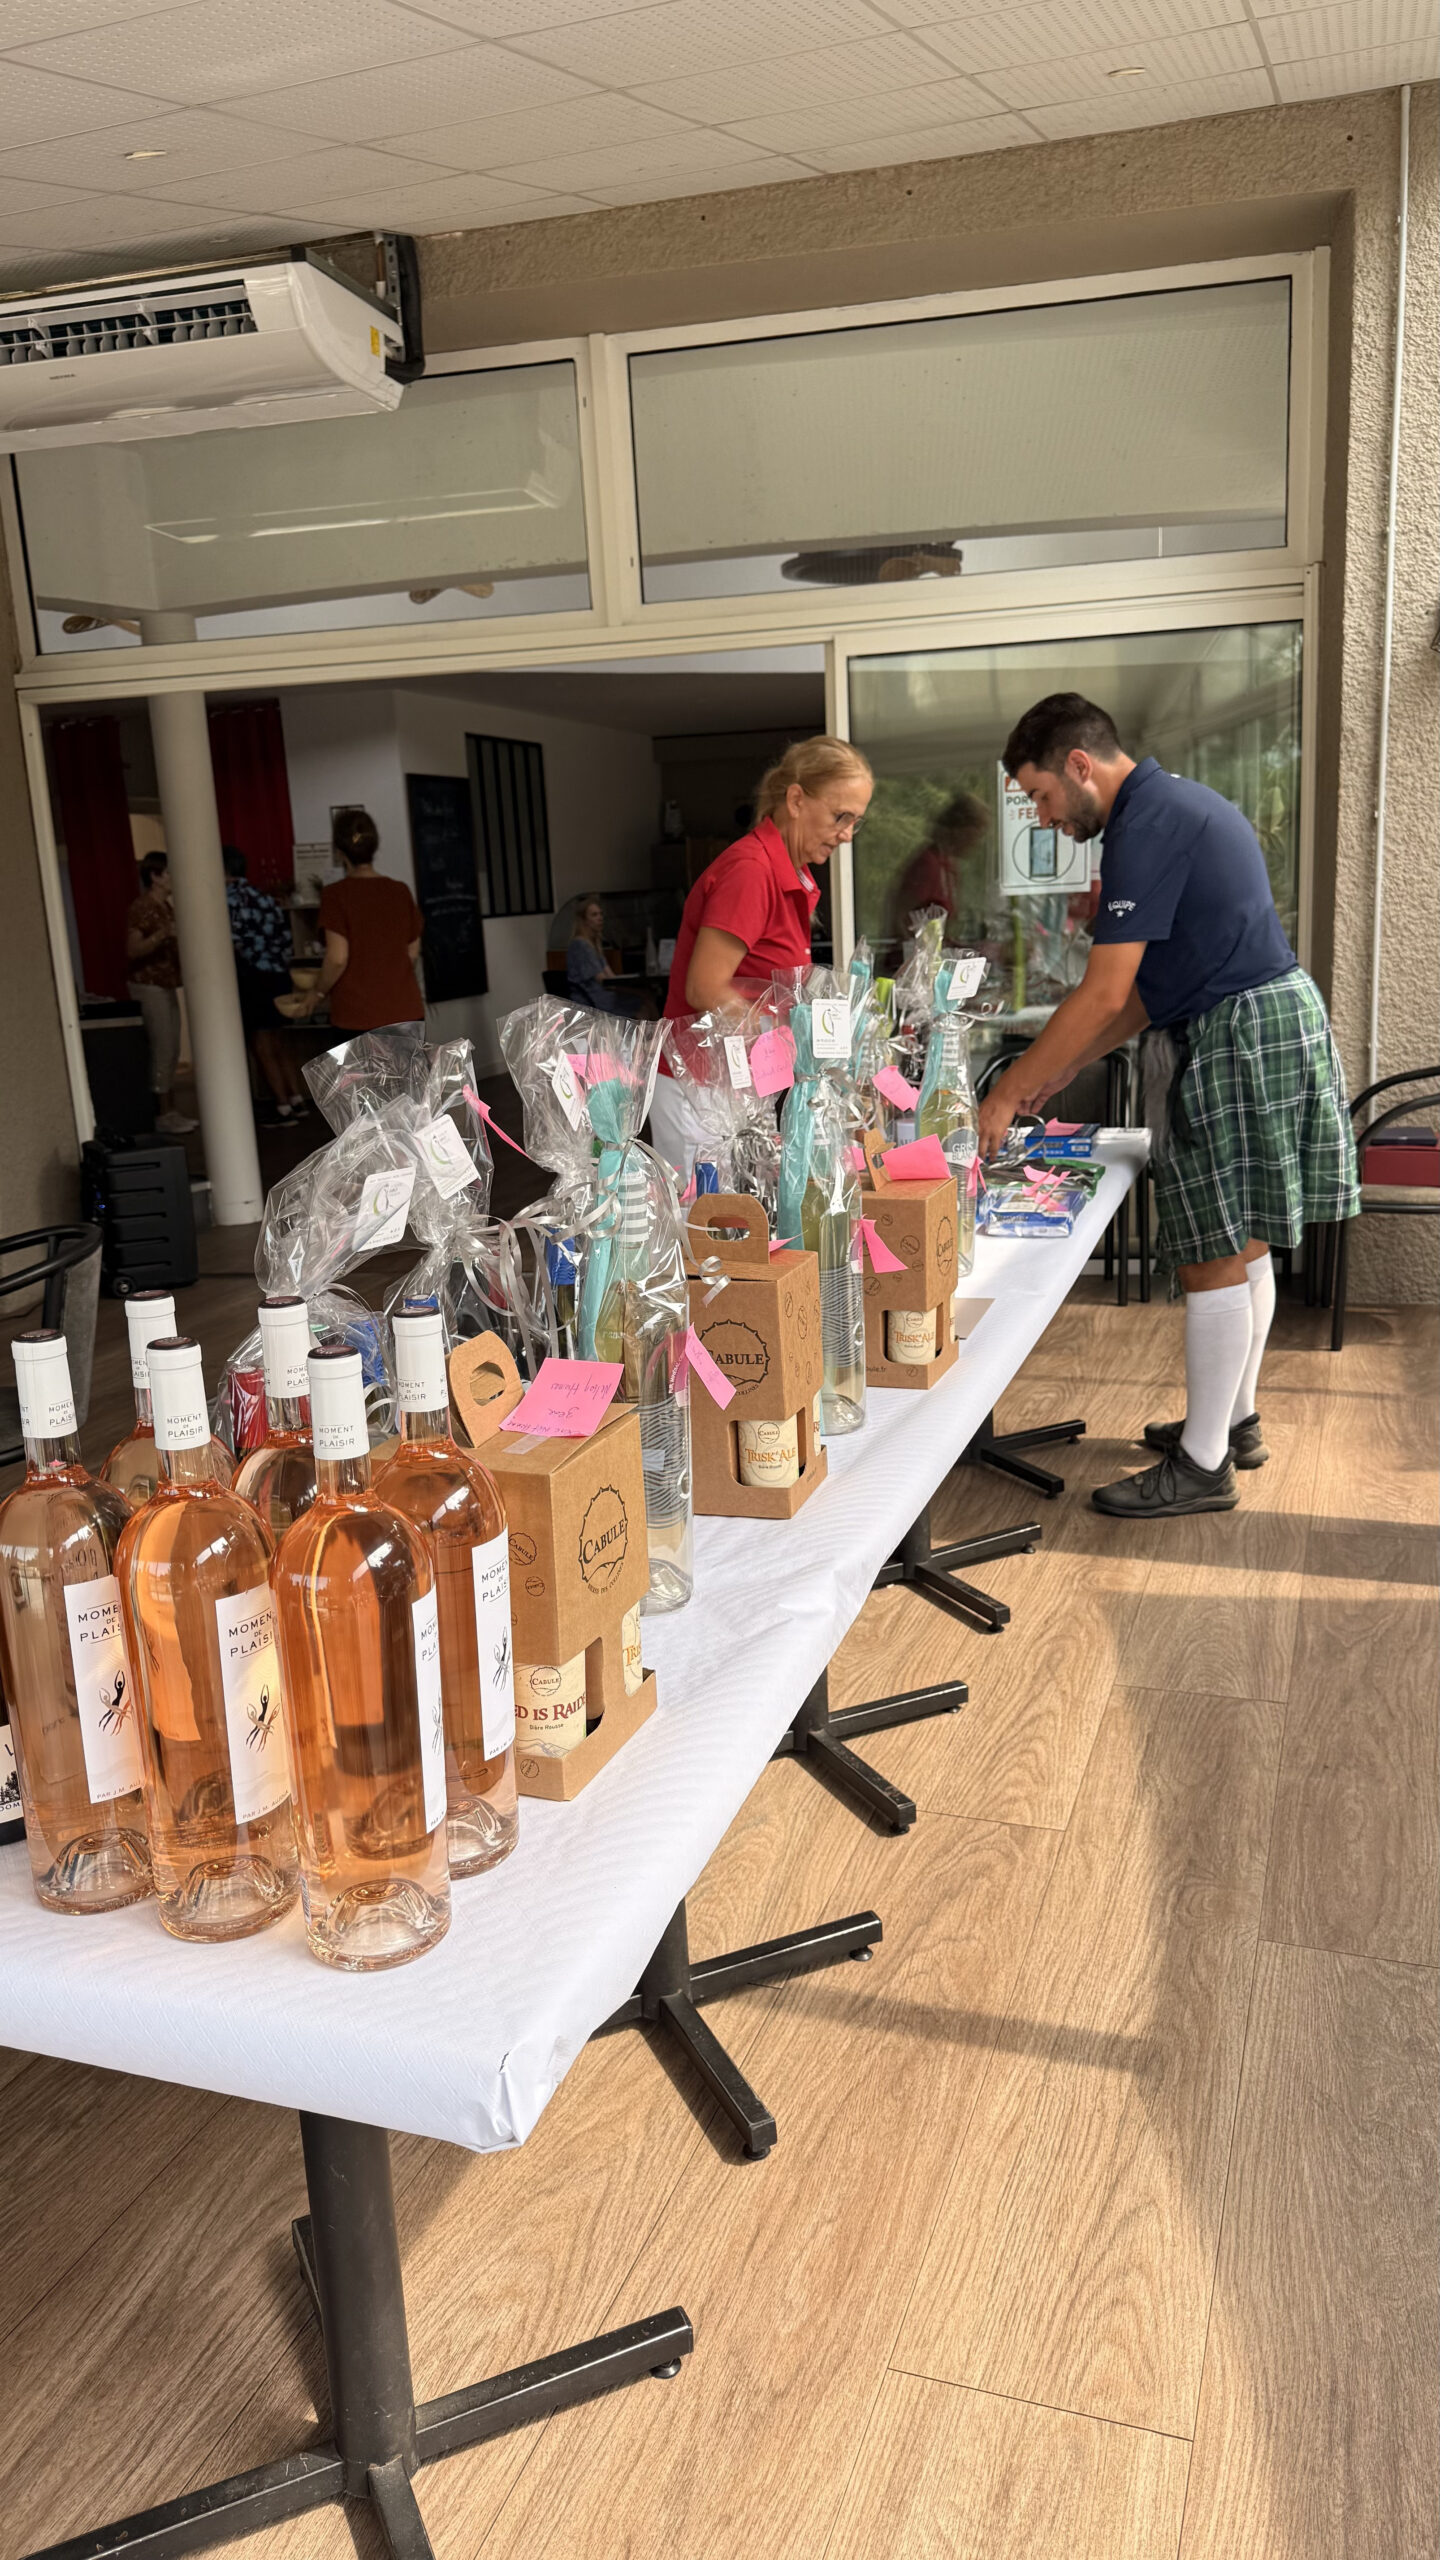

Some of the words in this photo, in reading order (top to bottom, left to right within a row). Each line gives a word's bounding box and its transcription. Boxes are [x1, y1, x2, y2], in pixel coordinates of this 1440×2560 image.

[708, 1350, 765, 1365] ABULE
[167, 1413, 202, 1424] MOMENT
[167, 1426, 203, 1438] PLAISIR
[319, 1426, 355, 1434] MOMENT
[319, 1438, 355, 1447] PLAISIR
[583, 1519, 626, 1565] CABULE
[106, 1617, 116, 1625] DE
[254, 1629, 262, 1638] DE
[532, 1677, 560, 1687] CABULE
[533, 1708, 548, 1721] IS
